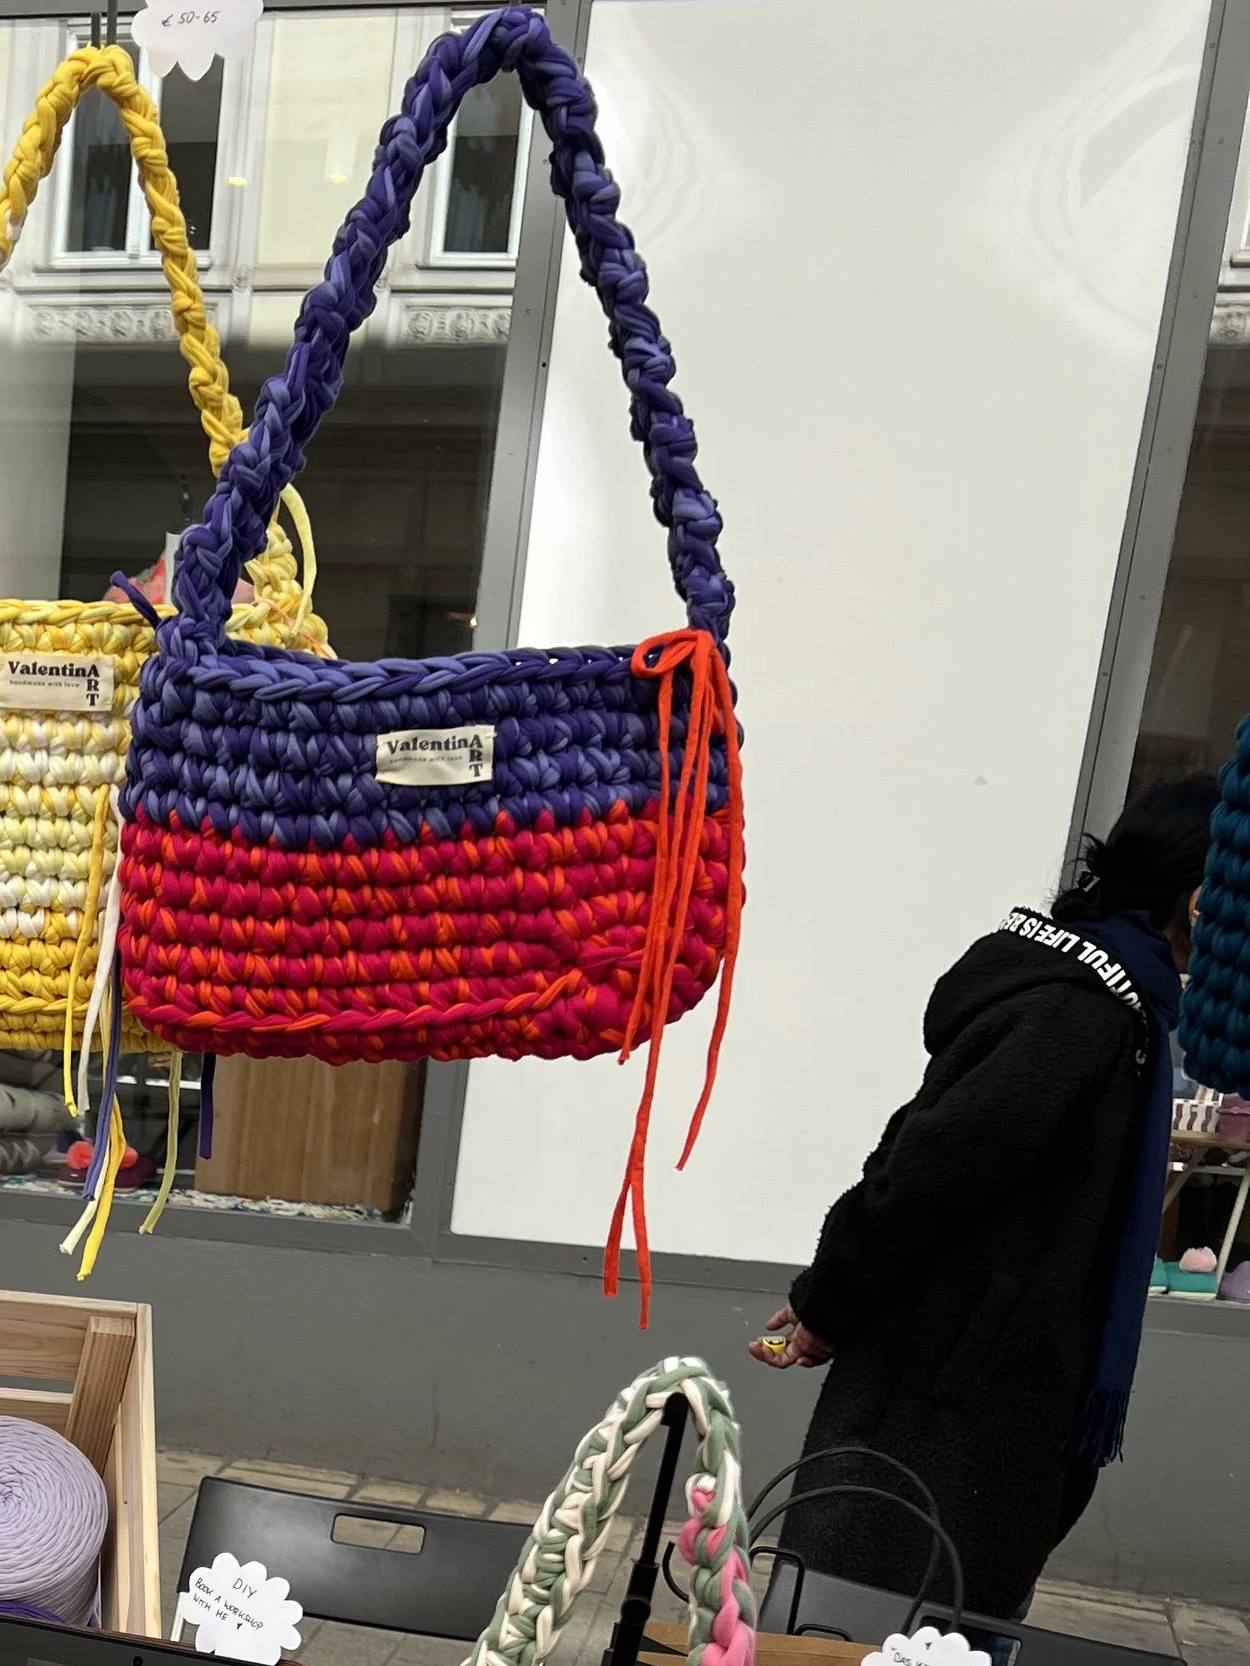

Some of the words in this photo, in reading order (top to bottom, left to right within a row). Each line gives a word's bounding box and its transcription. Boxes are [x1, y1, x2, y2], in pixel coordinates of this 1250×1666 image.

[177, 10, 221, 24] 50-65
[1034, 924, 1080, 952] LIFE
[232, 1577, 258, 1599] DIY
[193, 1593, 212, 1612] WITH
[214, 1595, 222, 1603] A
